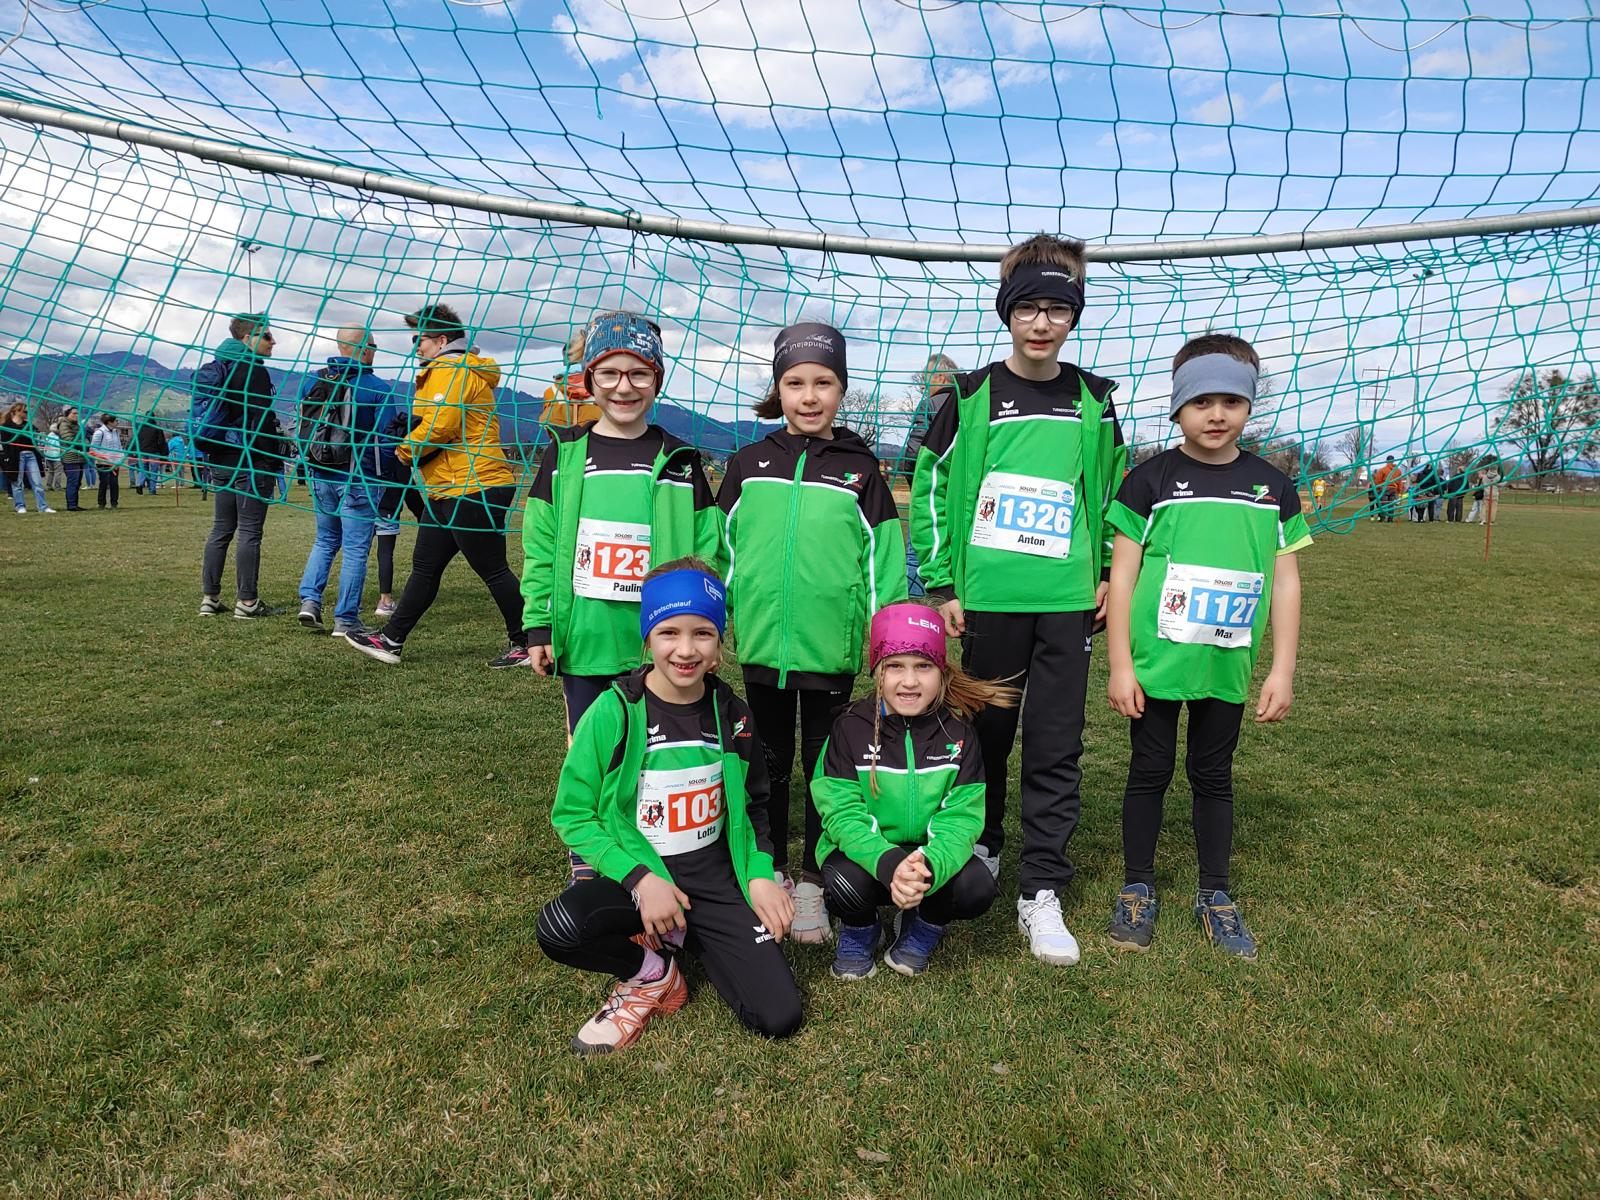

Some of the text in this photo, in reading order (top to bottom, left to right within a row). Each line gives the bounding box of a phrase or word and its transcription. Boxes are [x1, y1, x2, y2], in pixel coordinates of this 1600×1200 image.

[1000, 498, 1072, 534] 1326
[1017, 534, 1045, 546] Anton
[1194, 591, 1259, 624] 1127
[907, 617, 940, 634] LEKI
[1214, 628, 1233, 639] Max
[671, 787, 726, 828] 103
[697, 825, 716, 840] Lotta
